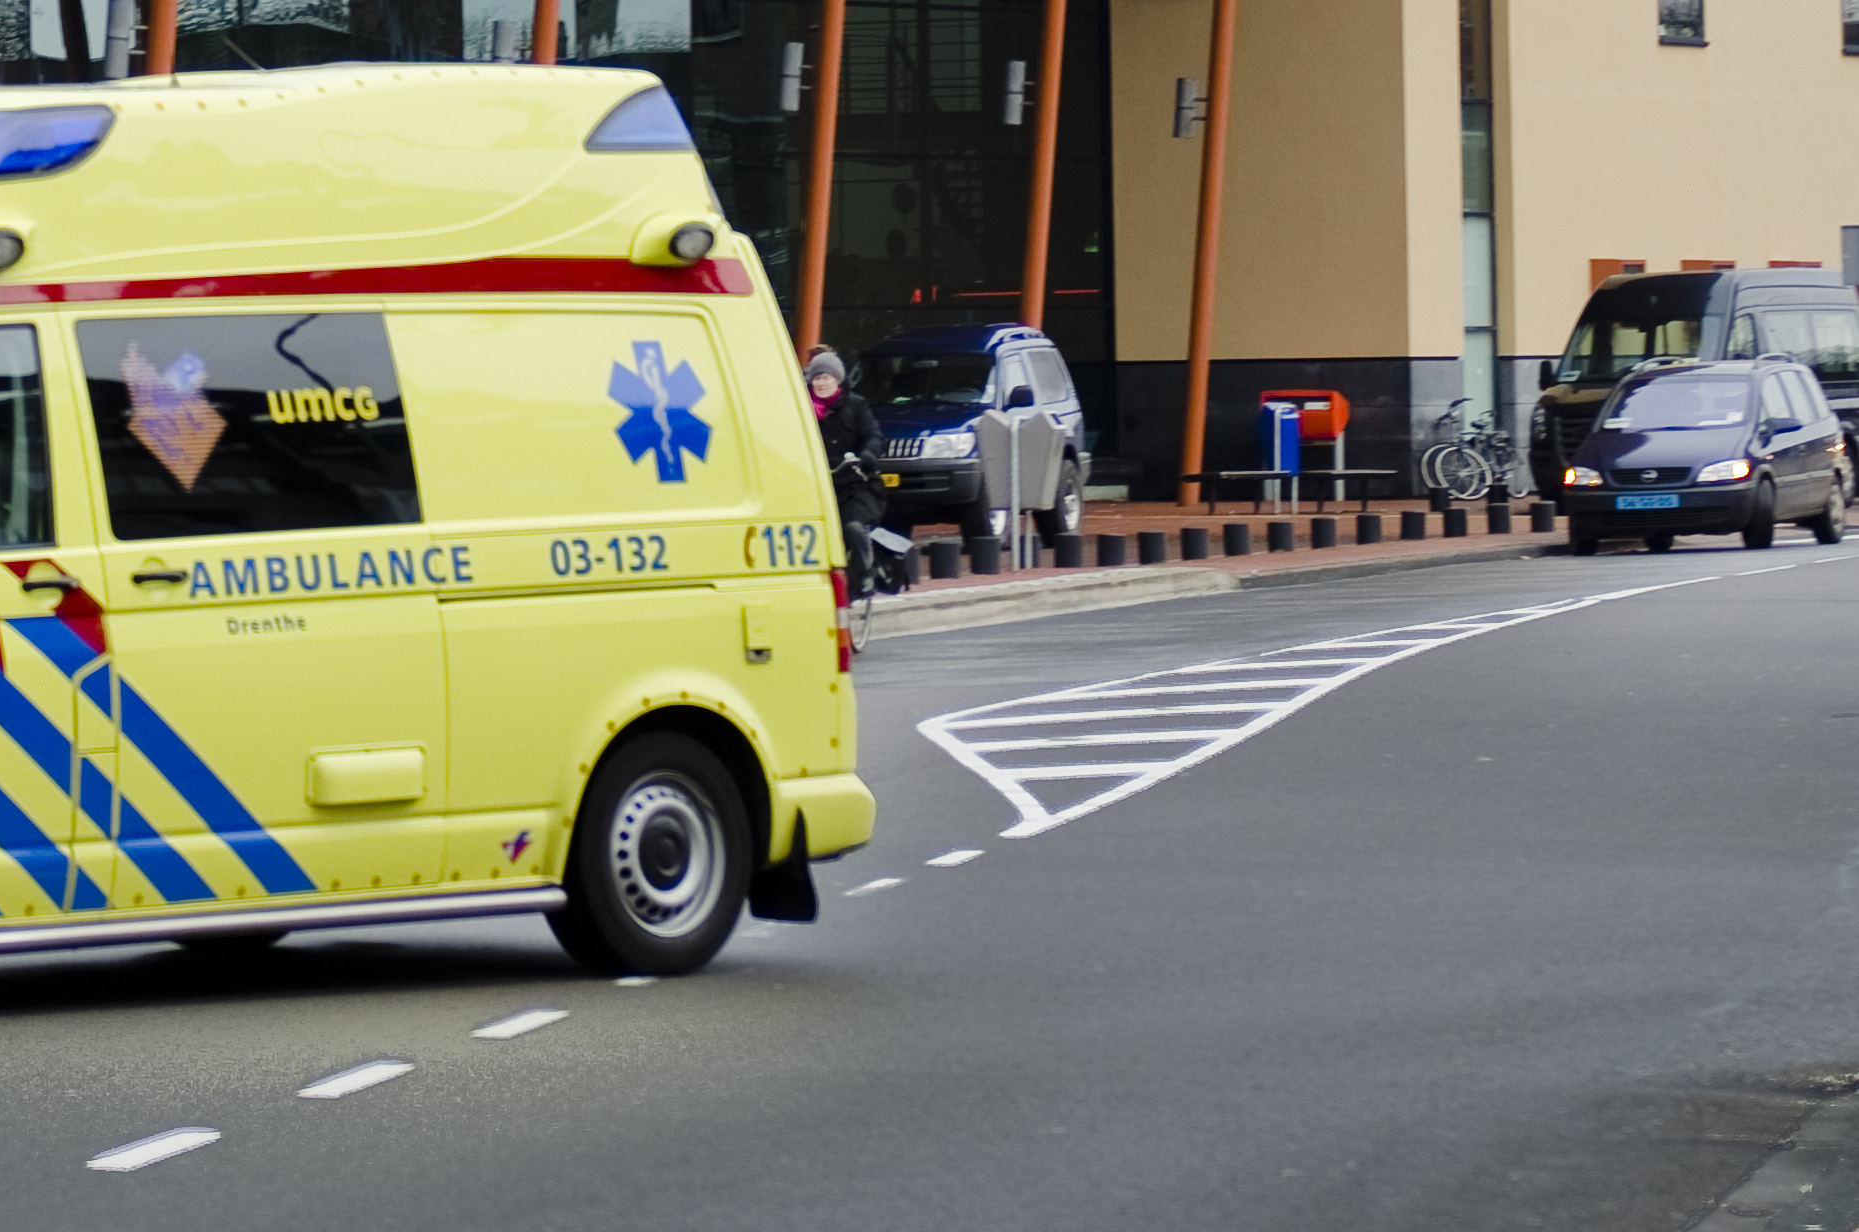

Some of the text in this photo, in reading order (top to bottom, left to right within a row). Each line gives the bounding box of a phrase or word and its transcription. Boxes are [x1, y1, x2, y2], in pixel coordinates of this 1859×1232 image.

[189, 534, 669, 599] AMBULANCE 03-132
[226, 614, 308, 636] Drenthe
